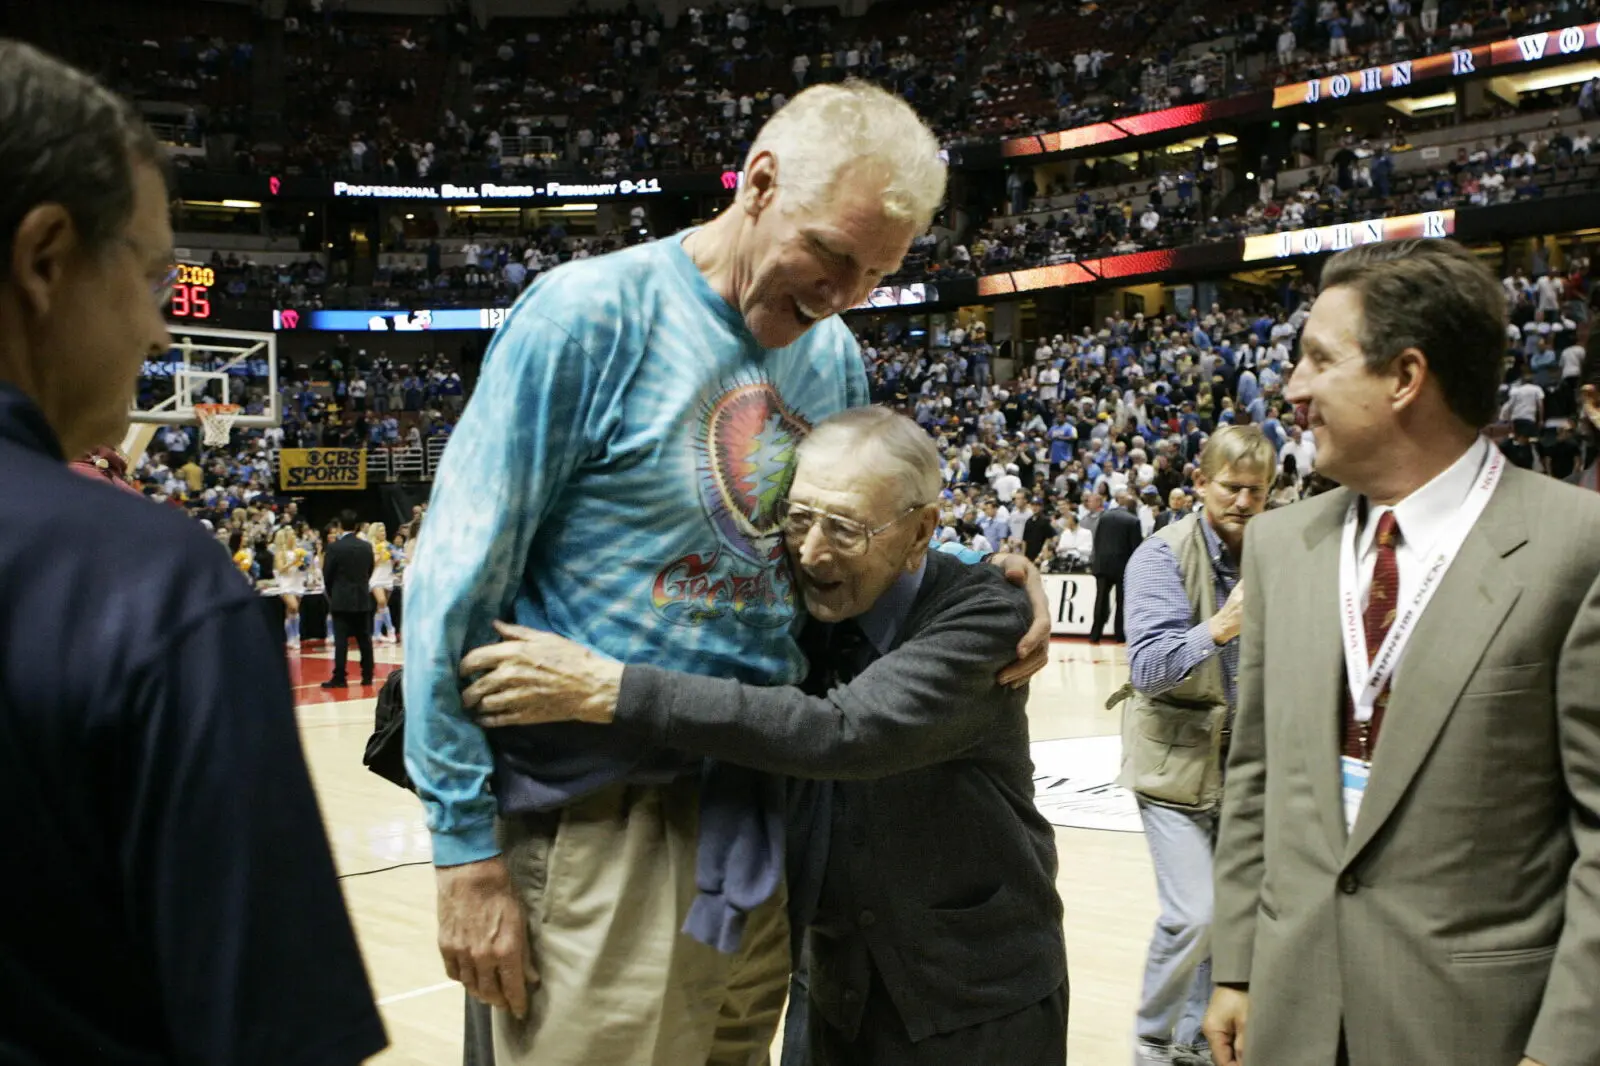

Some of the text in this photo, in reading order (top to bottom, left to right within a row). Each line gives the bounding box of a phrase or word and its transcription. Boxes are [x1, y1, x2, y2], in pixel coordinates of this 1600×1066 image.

[1304, 25, 1600, 104] JOHN R WO
[619, 178, 662, 194] 9-11
[1275, 211, 1446, 257] JOHN R
[171, 284, 210, 318] 35
[323, 450, 360, 466] CBS
[287, 466, 359, 486] SPORTS
[1056, 580, 1085, 624] R.
